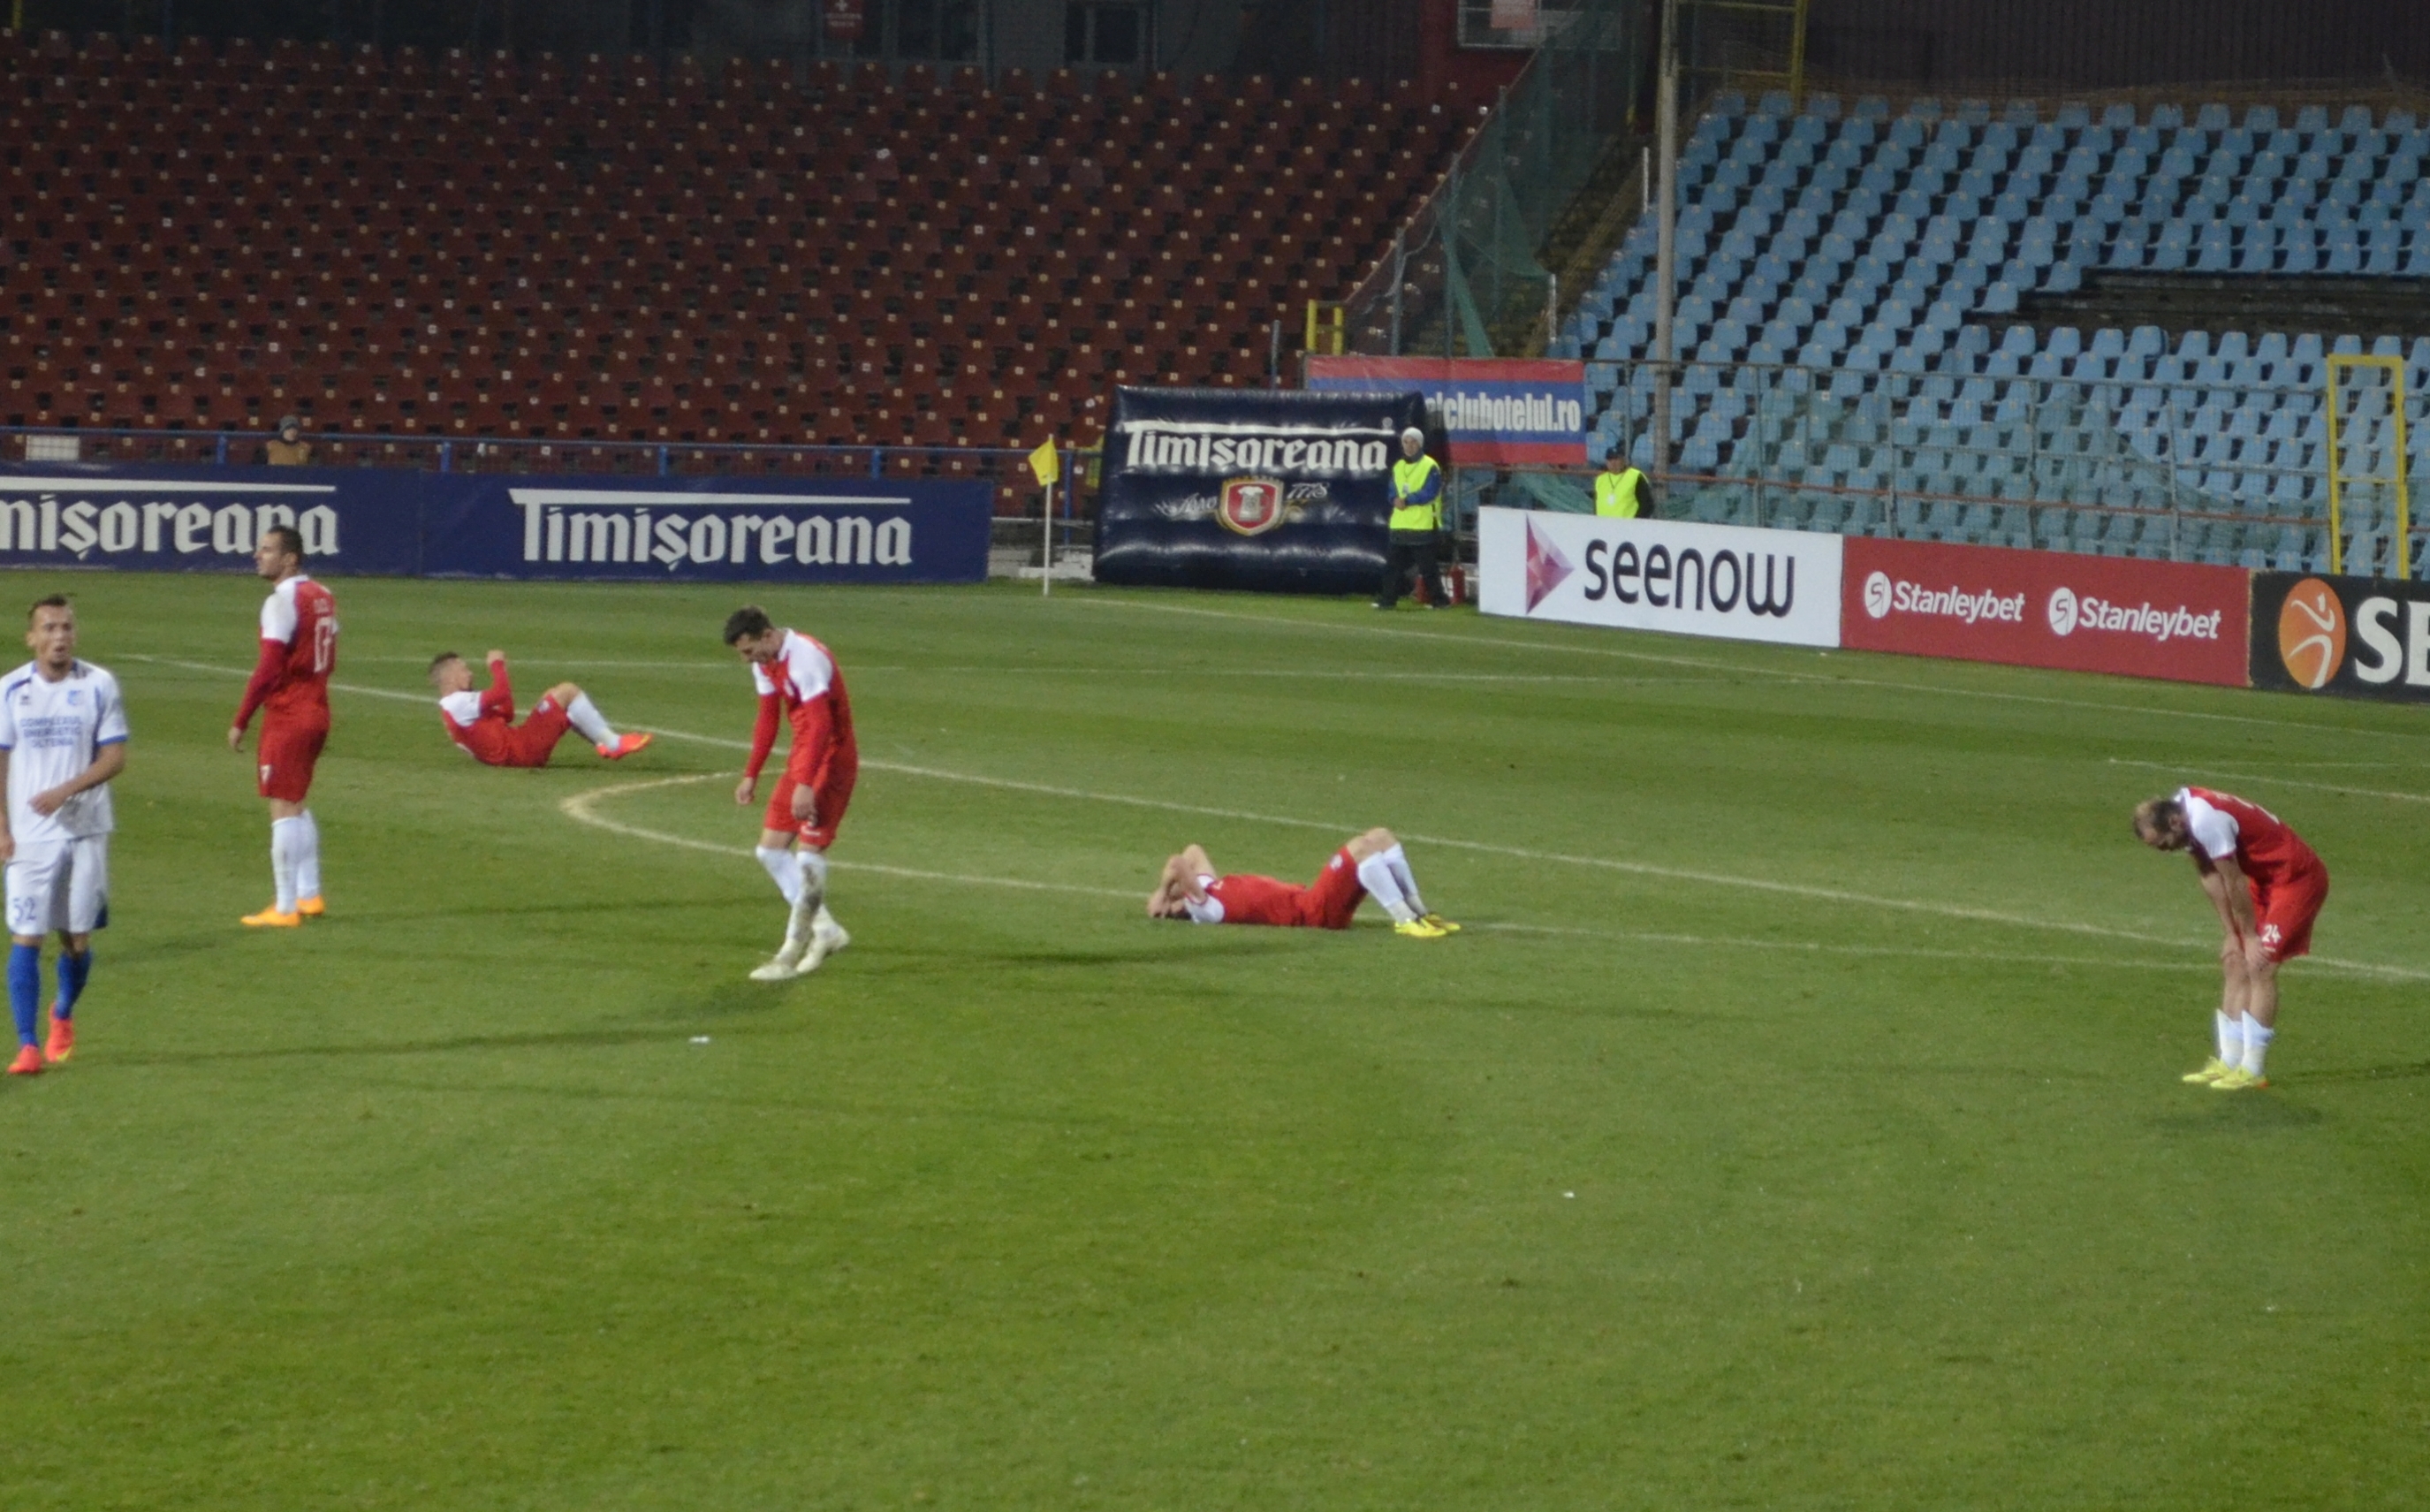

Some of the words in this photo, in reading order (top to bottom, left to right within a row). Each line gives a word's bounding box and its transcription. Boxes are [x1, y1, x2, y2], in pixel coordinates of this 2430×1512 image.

[1584, 538, 1796, 618] seenow
[1893, 581, 2025, 625] Stanleybet
[2079, 596, 2221, 642] Stanleybet
[2261, 923, 2282, 944] 24
